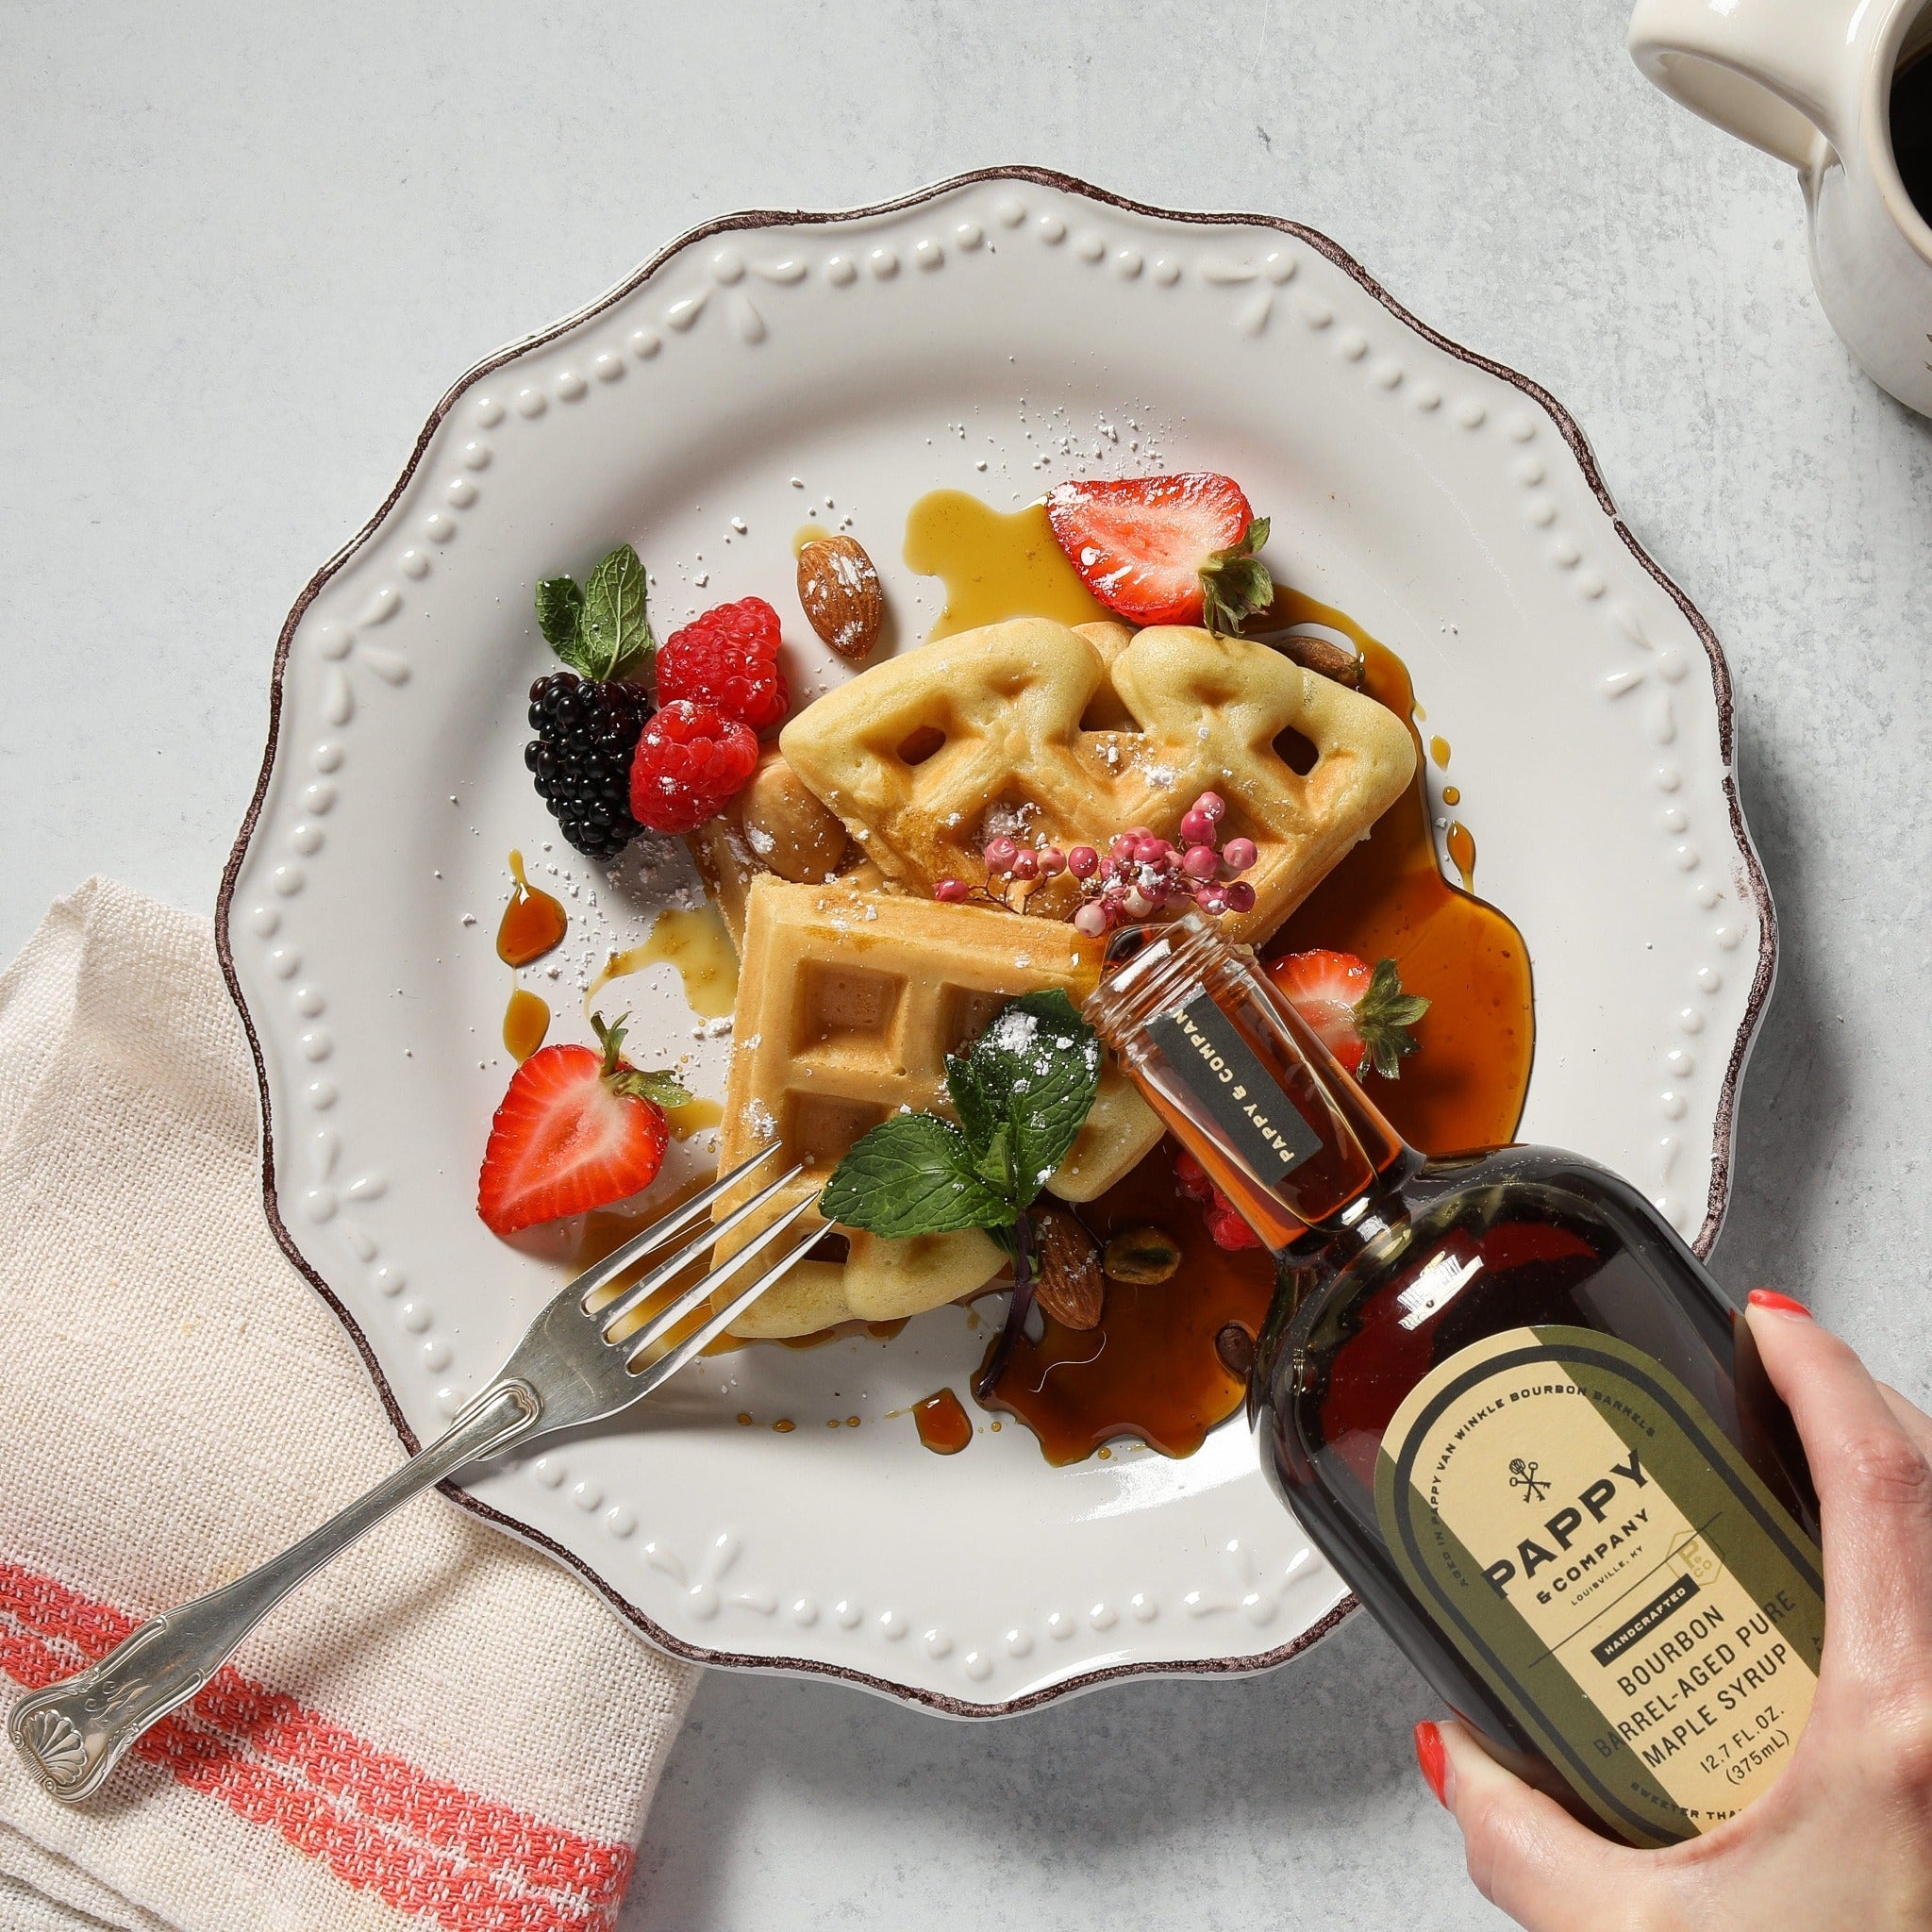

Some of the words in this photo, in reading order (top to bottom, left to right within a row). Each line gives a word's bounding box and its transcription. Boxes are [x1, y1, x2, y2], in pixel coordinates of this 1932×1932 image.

[1231, 1085, 1247, 1101] &
[1243, 1104, 1295, 1163] PAPPY
[1509, 1385, 1588, 1403] BOURBON
[1592, 1390, 1656, 1438] BARRELS
[1454, 1398, 1506, 1441] WINKLE
[1436, 1443, 1457, 1471] VAN
[1430, 1475, 1442, 1525] PAPPY
[1434, 1531, 1445, 1546] IN
[1480, 1449, 1649, 1600] PAPPY
[1442, 1551, 1469, 1587] AGED
[1629, 1545, 1643, 1558] KY
[1604, 1587, 1687, 1656] HANDCRAFTED
[1617, 1605, 1724, 1697] BOURBON
[1593, 1643, 1736, 1758] BARREL-AGED
[1735, 1590, 1796, 1648] PURE
[1641, 1705, 1718, 1768] MAPLE
[1717, 1642, 1787, 1710] SYRUP
[1700, 1743, 1731, 1774] 12.7
[1725, 1729, 1790, 1786] (375mL)
[1630, 1781, 1699, 1820] SWEETER
[1706, 1808, 1742, 1821] THA
